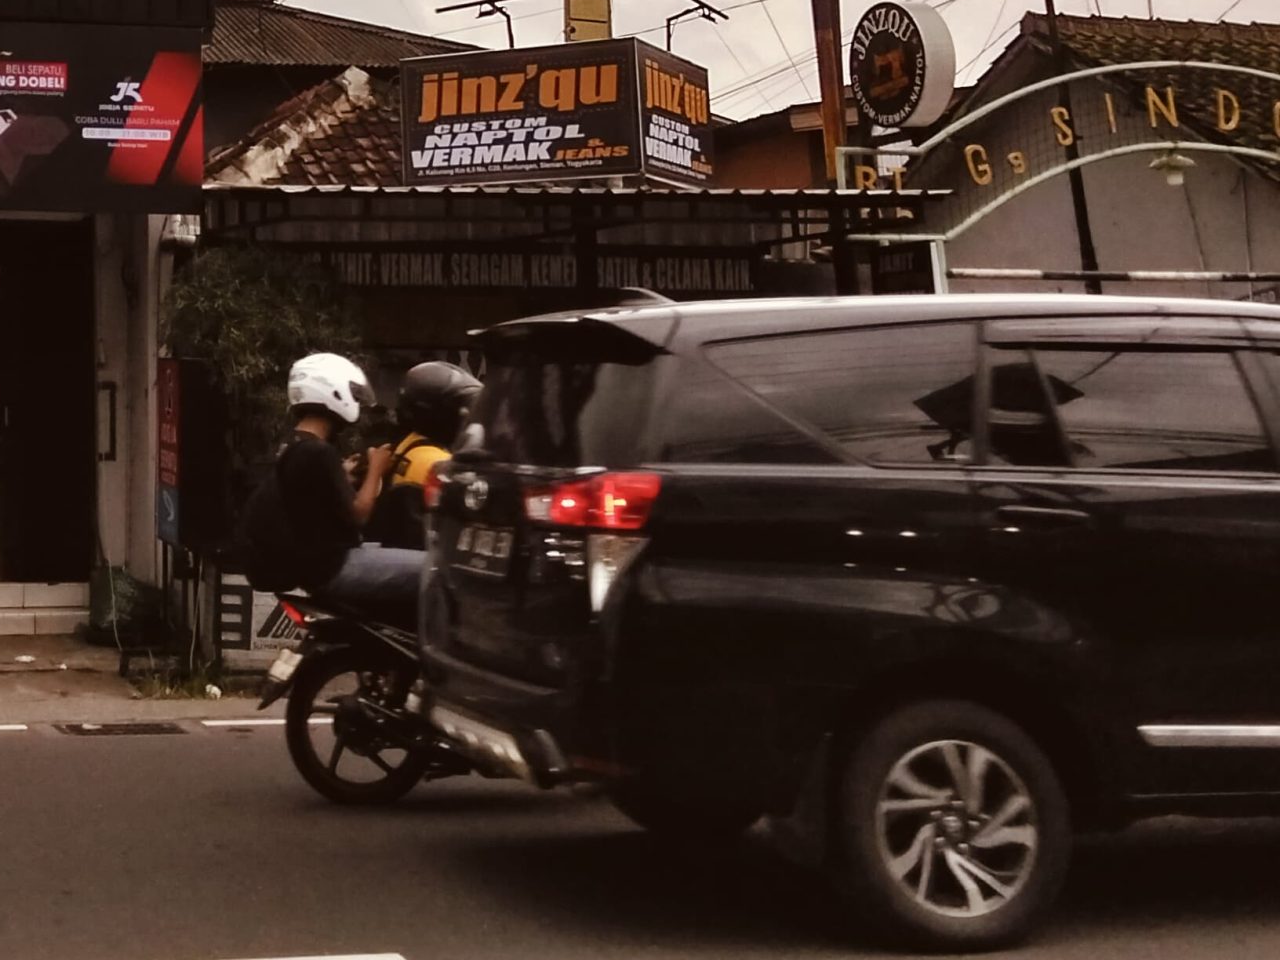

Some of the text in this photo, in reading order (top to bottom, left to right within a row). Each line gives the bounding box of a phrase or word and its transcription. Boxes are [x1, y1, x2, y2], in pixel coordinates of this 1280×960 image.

[853, 7, 916, 61] JINZQU
[5, 64, 26, 74] BELI
[18, 75, 65, 89] DOBEL!
[852, 49, 924, 126] CUSTOM VERMAK NAPTOL
[74, 115, 99, 124] COBA
[433, 116, 548, 135] CUSTOM
[651, 114, 690, 136] CUSTOM
[424, 124, 585, 149] NAPTOL
[649, 122, 701, 153] NAPTOL
[411, 141, 629, 169] VERMAK JEANS
[645, 136, 692, 169] VERMAK
[656, 257, 712, 290] CELANA
